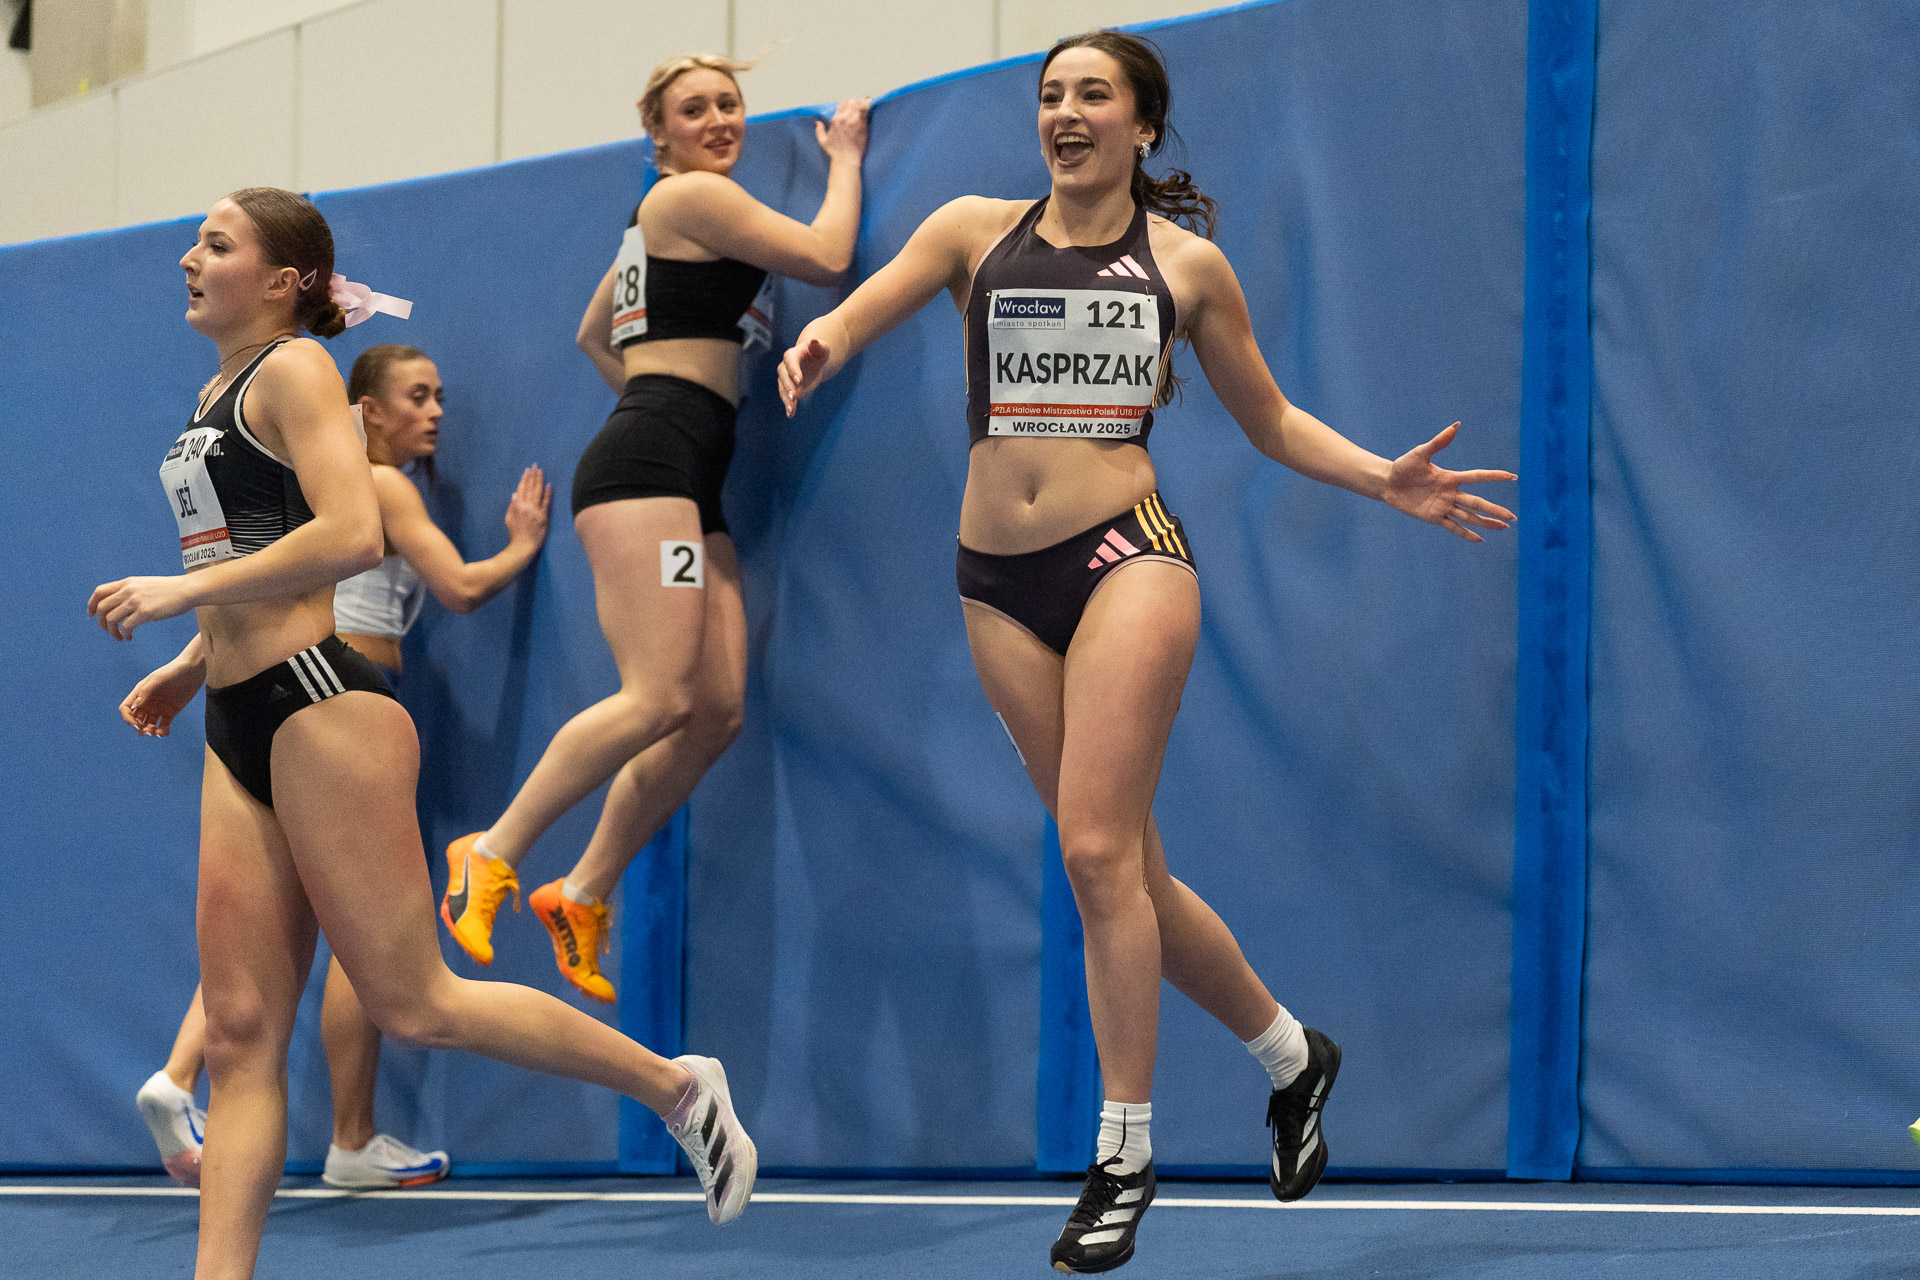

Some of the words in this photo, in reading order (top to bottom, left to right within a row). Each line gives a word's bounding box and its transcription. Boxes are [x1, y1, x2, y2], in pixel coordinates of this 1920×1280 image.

[998, 300, 1062, 314] Wrocław
[1086, 300, 1146, 330] 121
[996, 320, 1025, 328] miasto
[1027, 320, 1062, 329] spotkań
[996, 352, 1154, 386] KASPRZAK
[1012, 406, 1042, 414] Halowe
[1042, 407, 1093, 415] Mistrzostwa
[1093, 407, 1117, 416] Polski
[1119, 408, 1133, 416] U18
[1012, 421, 1093, 434] WROCŁAW
[1096, 423, 1131, 434] 2025
[184, 434, 208, 462] 240
[200, 547, 216, 560] 2025
[672, 545, 696, 583] 2
[550, 903, 581, 967] NITRO
